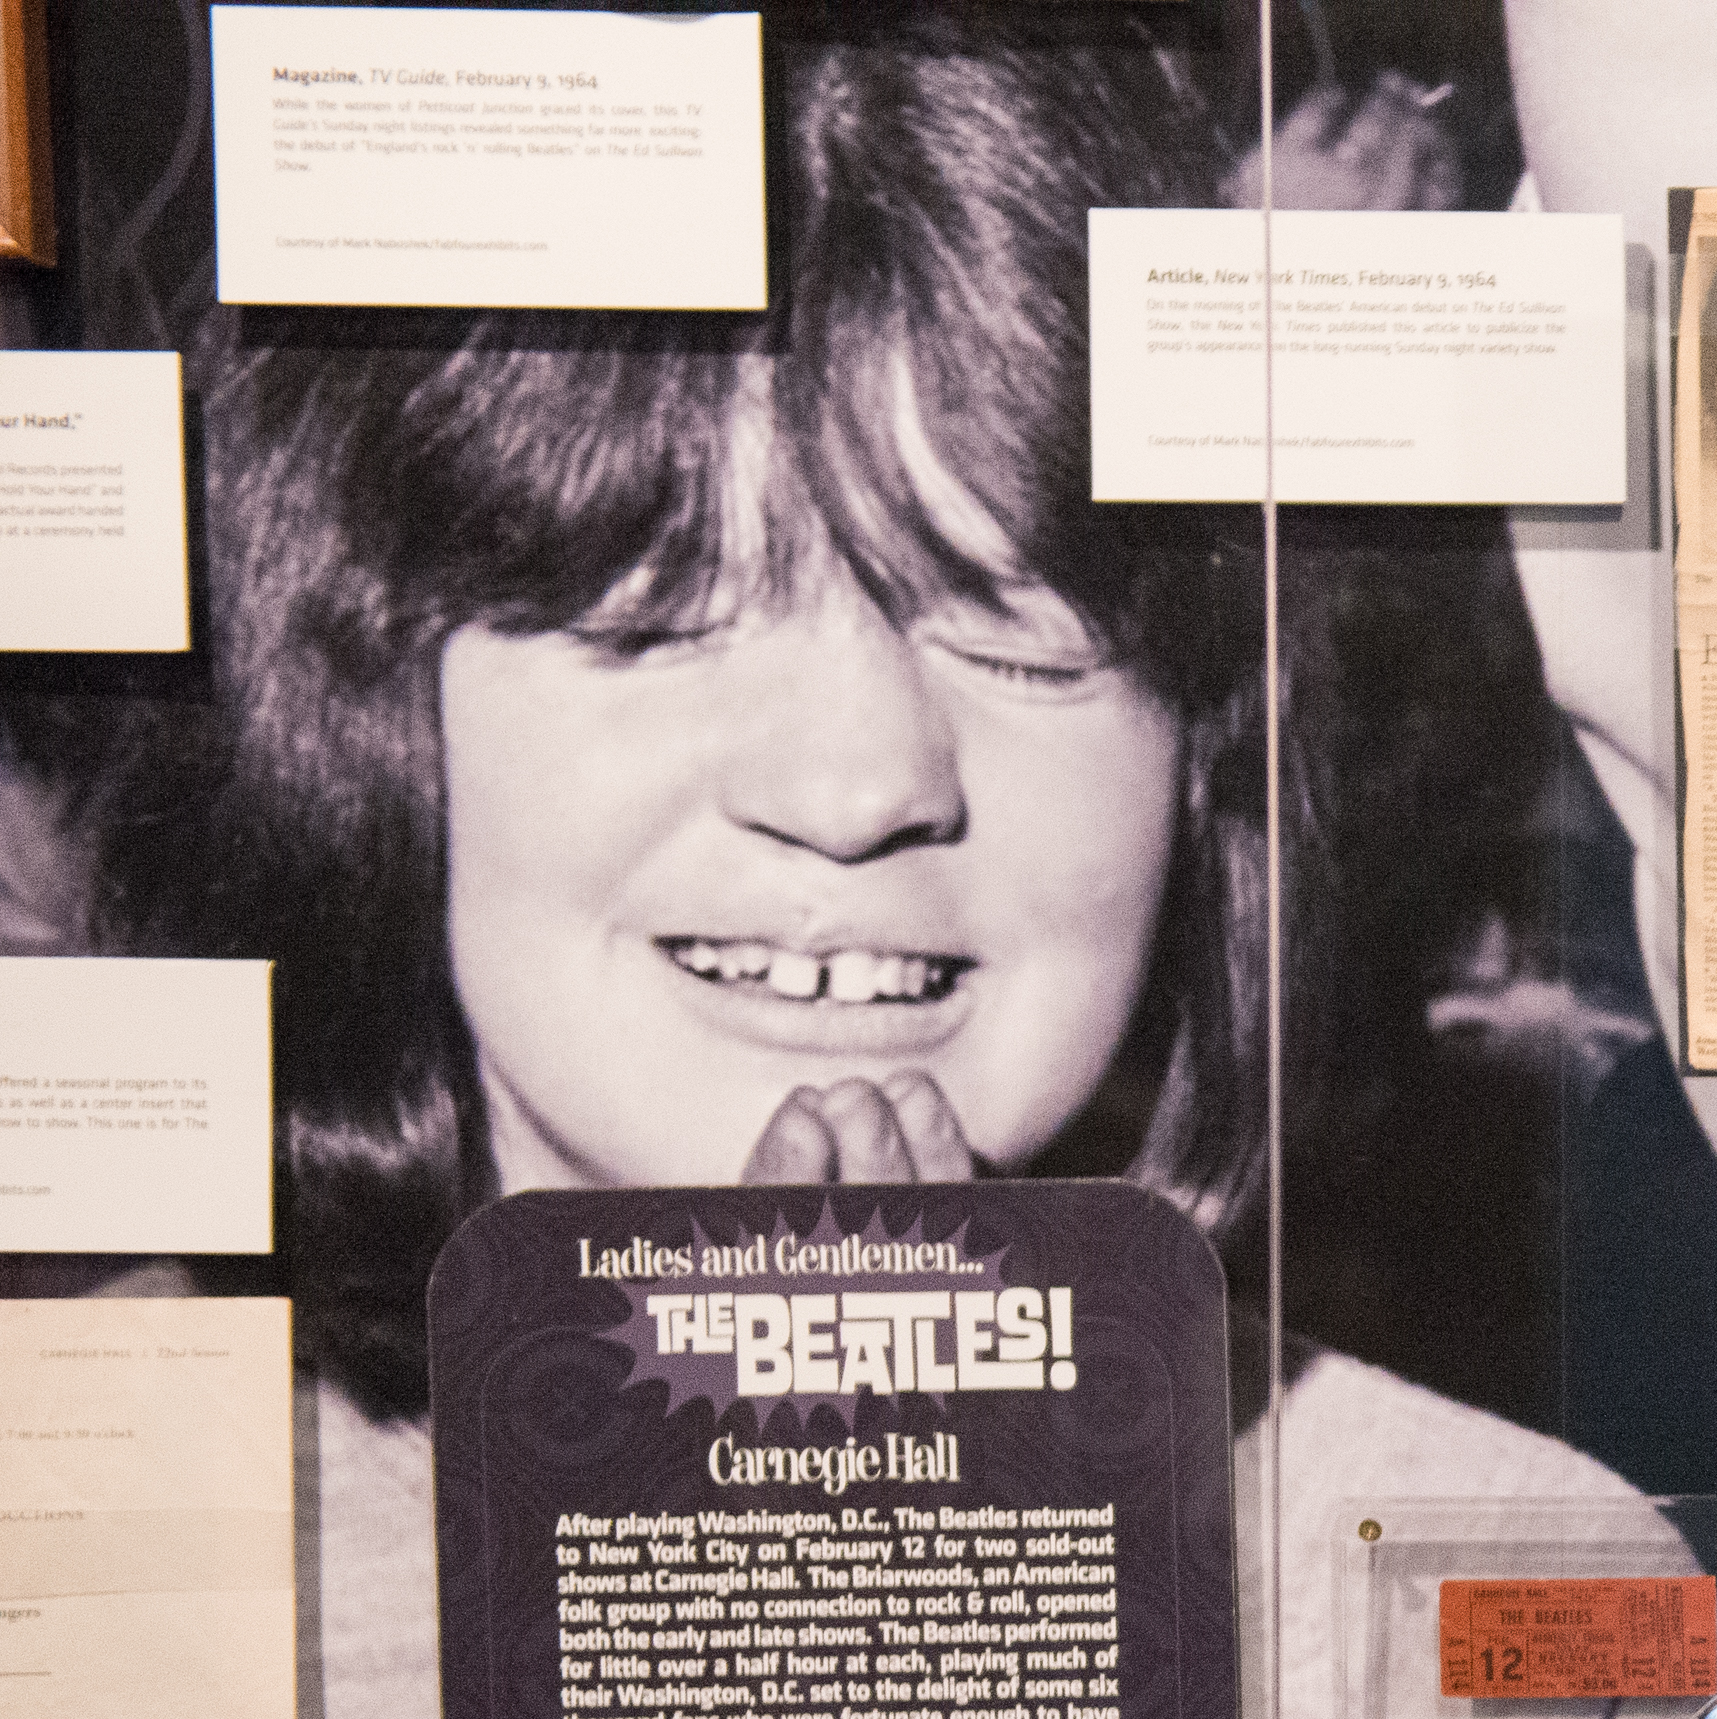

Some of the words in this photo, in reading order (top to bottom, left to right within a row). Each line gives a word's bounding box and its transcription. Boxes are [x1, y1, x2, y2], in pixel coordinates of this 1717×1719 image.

[270, 65, 363, 89] Magazine,
[370, 67, 392, 85] TV
[396, 69, 450, 88] Guide,
[455, 70, 532, 89] February
[557, 73, 599, 90] 1964
[1145, 267, 1210, 286] Article,
[1213, 268, 1251, 286] New
[1300, 269, 1355, 288] Times,
[1357, 269, 1433, 289] February
[1457, 271, 1498, 290] 1964
[579, 1237, 695, 1279] Ladies
[699, 1234, 768, 1279] and
[773, 1234, 985, 1277] Gentlemen...
[646, 1292, 736, 1355] THE
[737, 1287, 1077, 1398] BEATLES!
[707, 1432, 881, 1495] Carnegie
[885, 1429, 960, 1483] Hall
[555, 1513, 612, 1536] After
[615, 1511, 696, 1539] playing
[697, 1509, 838, 1536] Washington,
[841, 1507, 890, 1532] D.C.,
[893, 1507, 936, 1530] The
[938, 1505, 1019, 1530] Beatles
[1021, 1503, 1115, 1528] returned
[1480, 1646, 1525, 1683] 12
